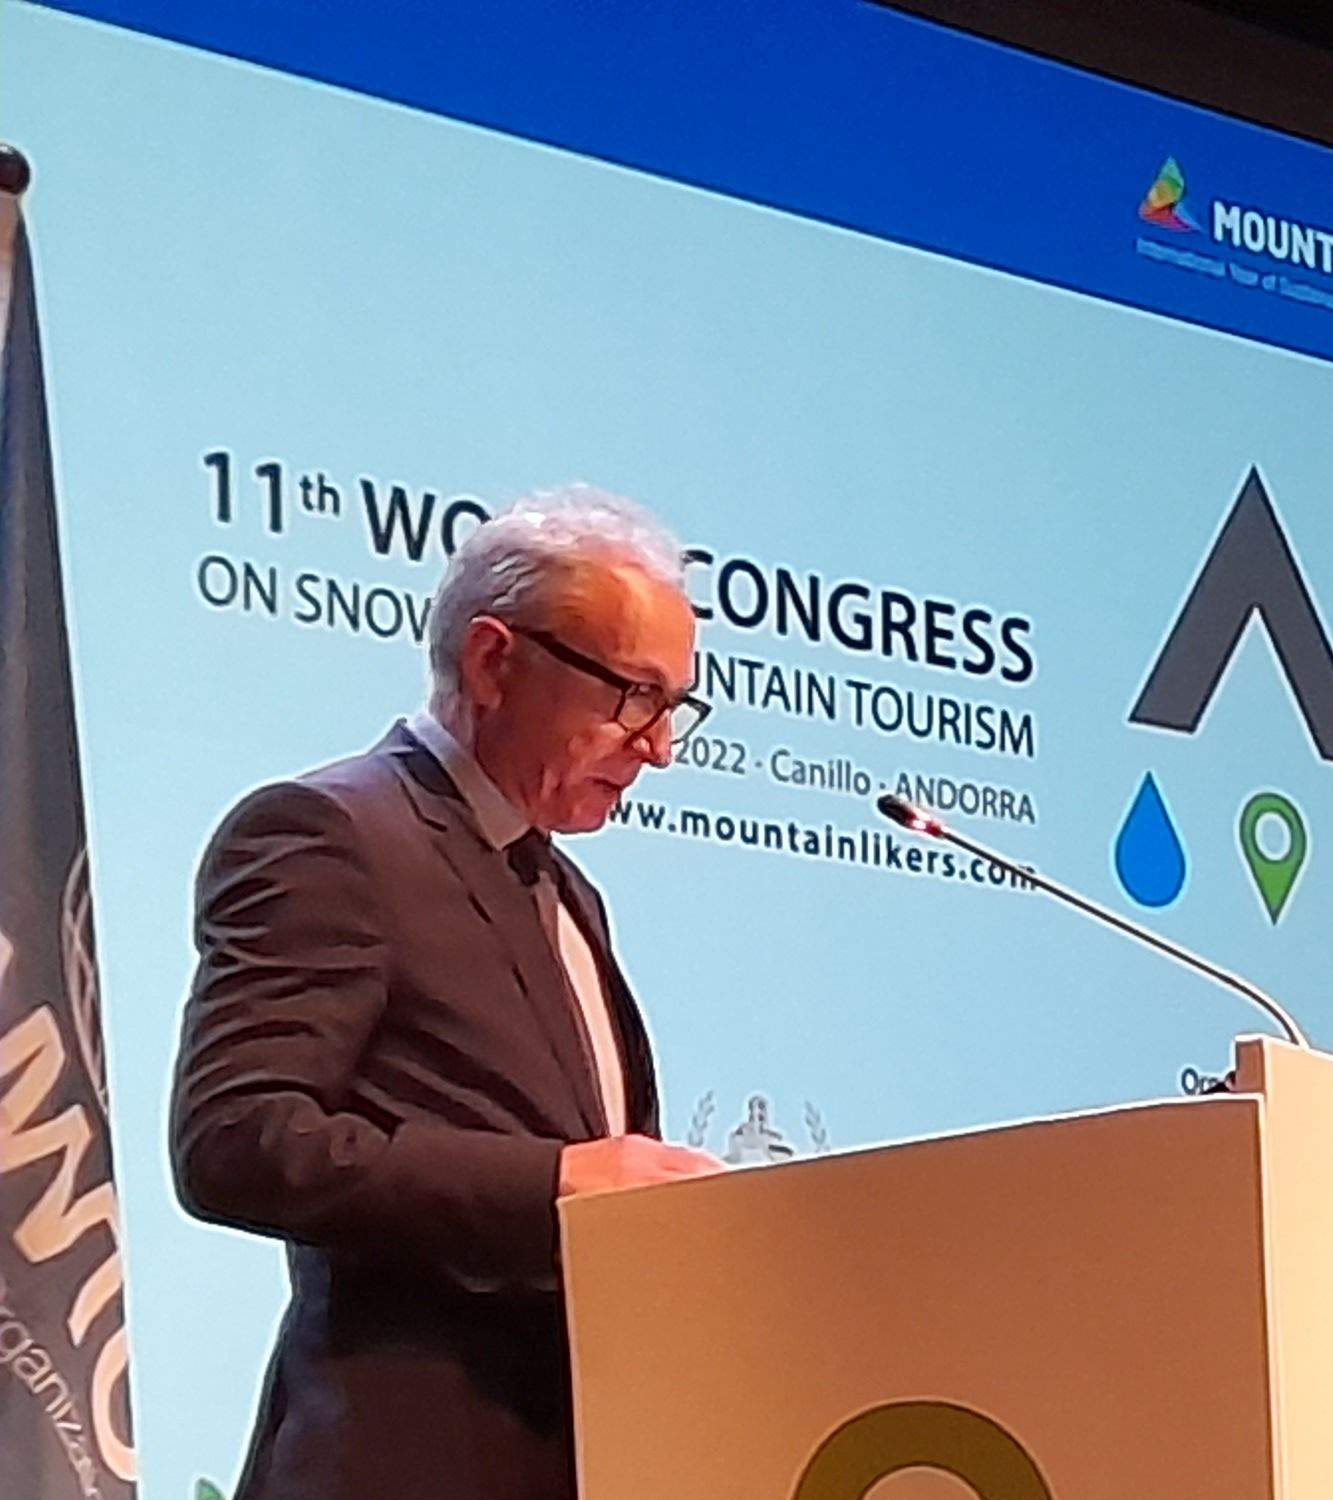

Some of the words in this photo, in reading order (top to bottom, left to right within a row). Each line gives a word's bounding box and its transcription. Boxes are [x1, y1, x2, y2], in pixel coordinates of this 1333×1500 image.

[203, 451, 340, 534] 11th
[198, 555, 277, 616] ON
[846, 679, 1035, 759] TOURISM
[770, 749, 872, 796] Canillo
[895, 773, 1036, 825] ANDORRA
